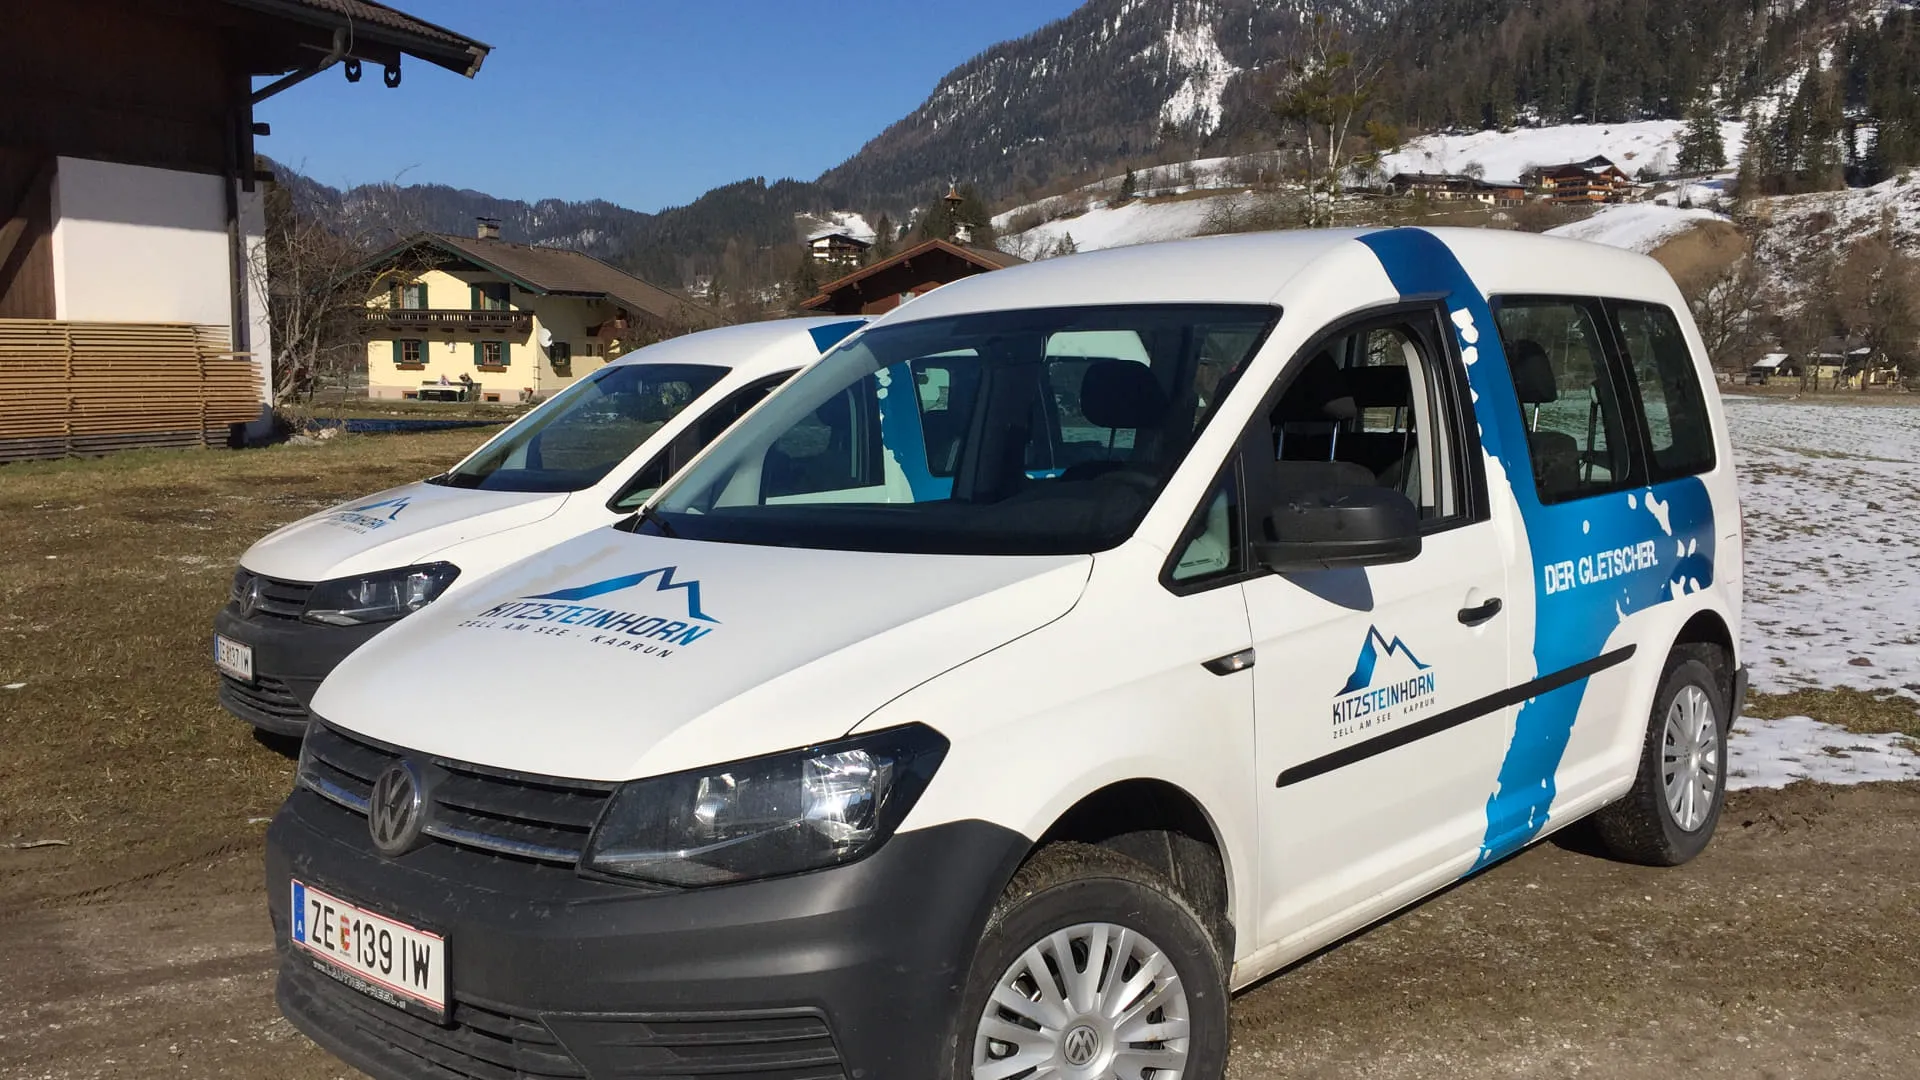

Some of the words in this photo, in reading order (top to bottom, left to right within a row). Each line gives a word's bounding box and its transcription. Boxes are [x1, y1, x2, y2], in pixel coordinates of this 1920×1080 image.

[1544, 560, 1576, 595] DER
[458, 619, 492, 628] ZELL
[504, 621, 529, 632] AM
[534, 626, 570, 637] SEE
[590, 634, 673, 659] KAPRUN
[477, 602, 713, 646] KITZSTEINHORN
[1332, 671, 1435, 726] KITZSTEINHORN
[1333, 727, 1354, 739] ZELL
[1359, 719, 1372, 731] AM
[1377, 713, 1392, 724] SEE
[1403, 697, 1435, 715] KAPRUN
[311, 900, 335, 951] ZE
[353, 919, 393, 975] 139
[402, 936, 430, 990] IW
